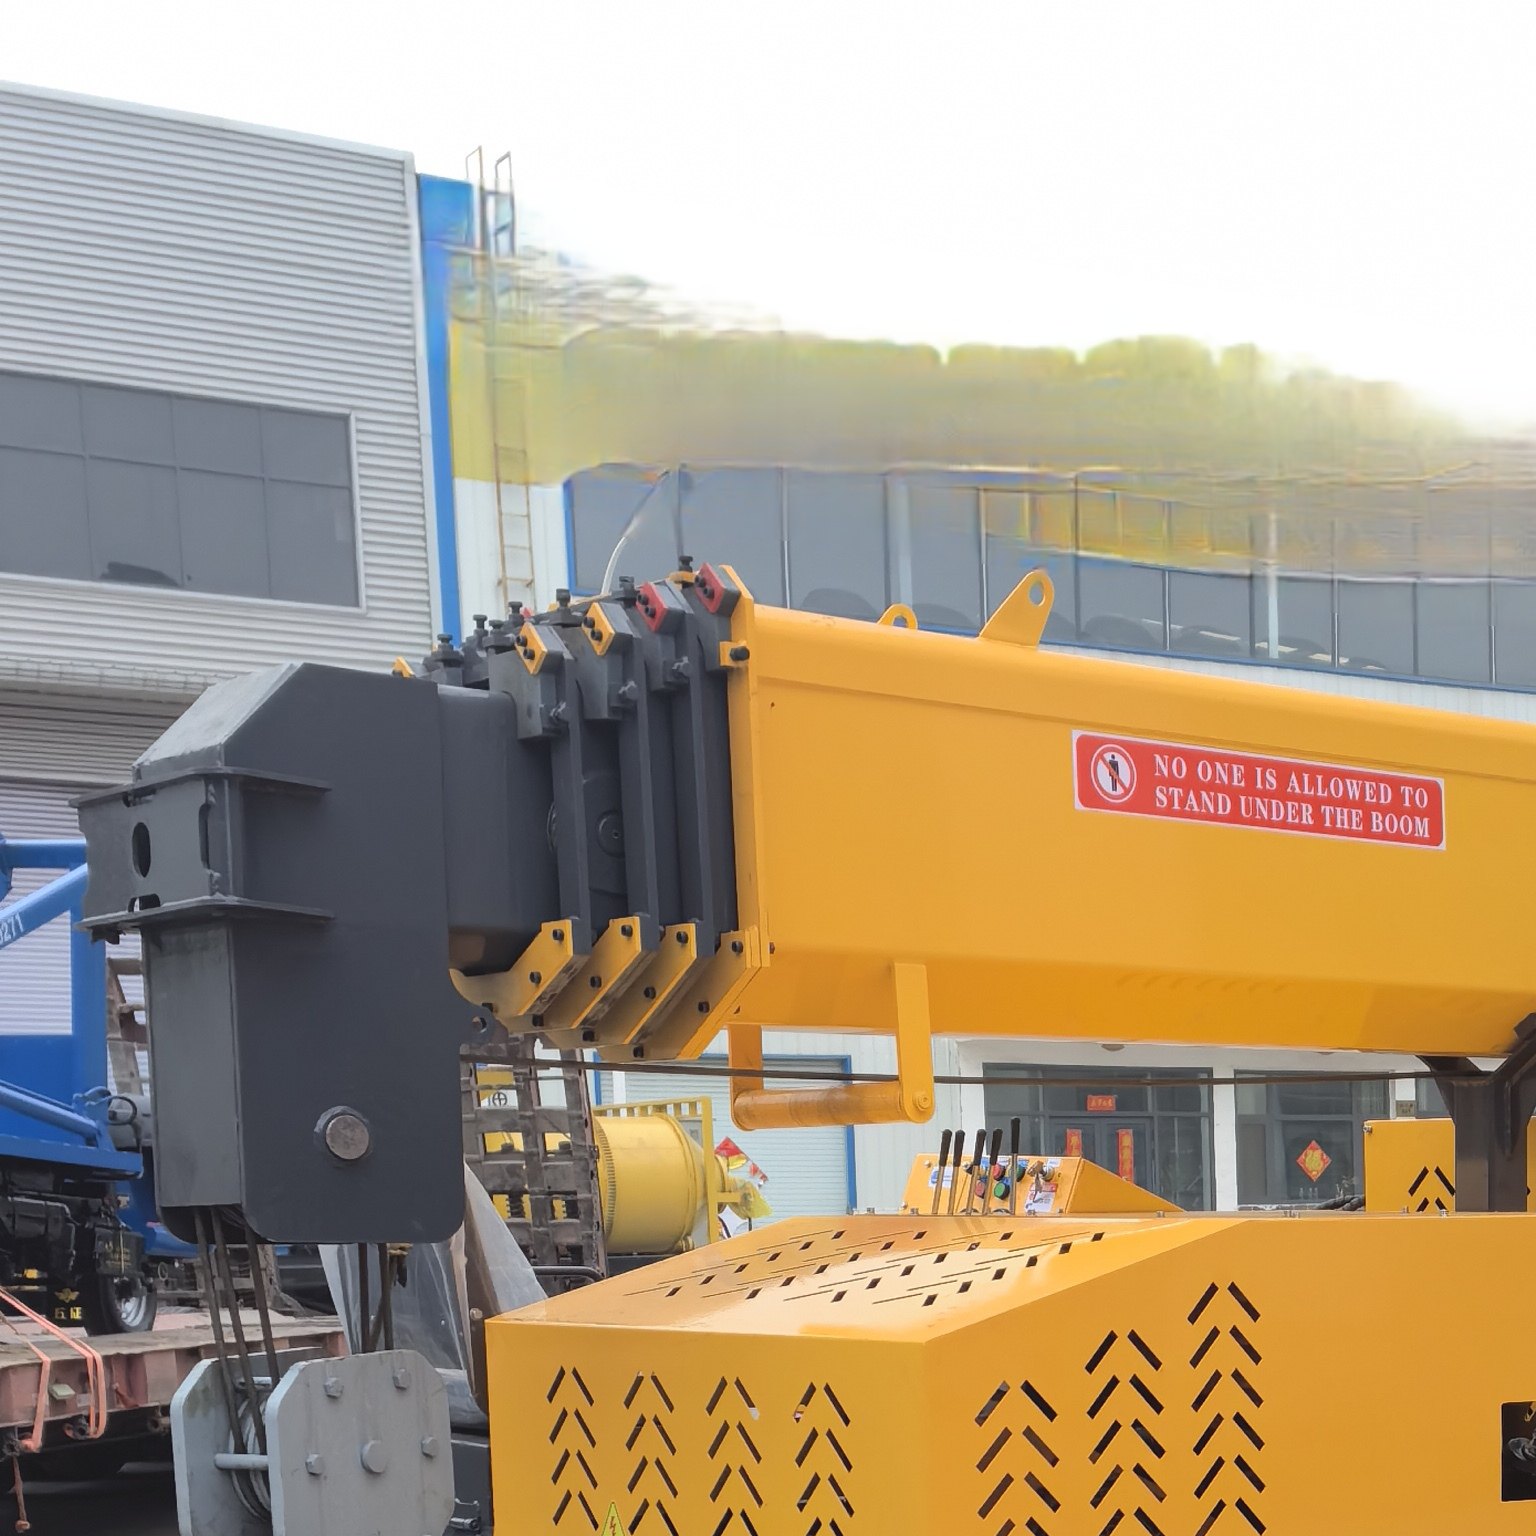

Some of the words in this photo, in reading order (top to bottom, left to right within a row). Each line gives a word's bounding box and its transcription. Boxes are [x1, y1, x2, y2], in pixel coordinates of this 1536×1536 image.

[1153, 754, 1187, 779] NO
[1197, 760, 1245, 787] ONE
[1254, 767, 1277, 790] IS
[1286, 771, 1392, 804] ALLOWED
[1400, 785, 1429, 808] TO
[1155, 785, 1232, 815] STAND
[1239, 795, 1315, 825] UNDER
[1321, 805, 1363, 831] THE
[1370, 811, 1430, 838] BOOM
